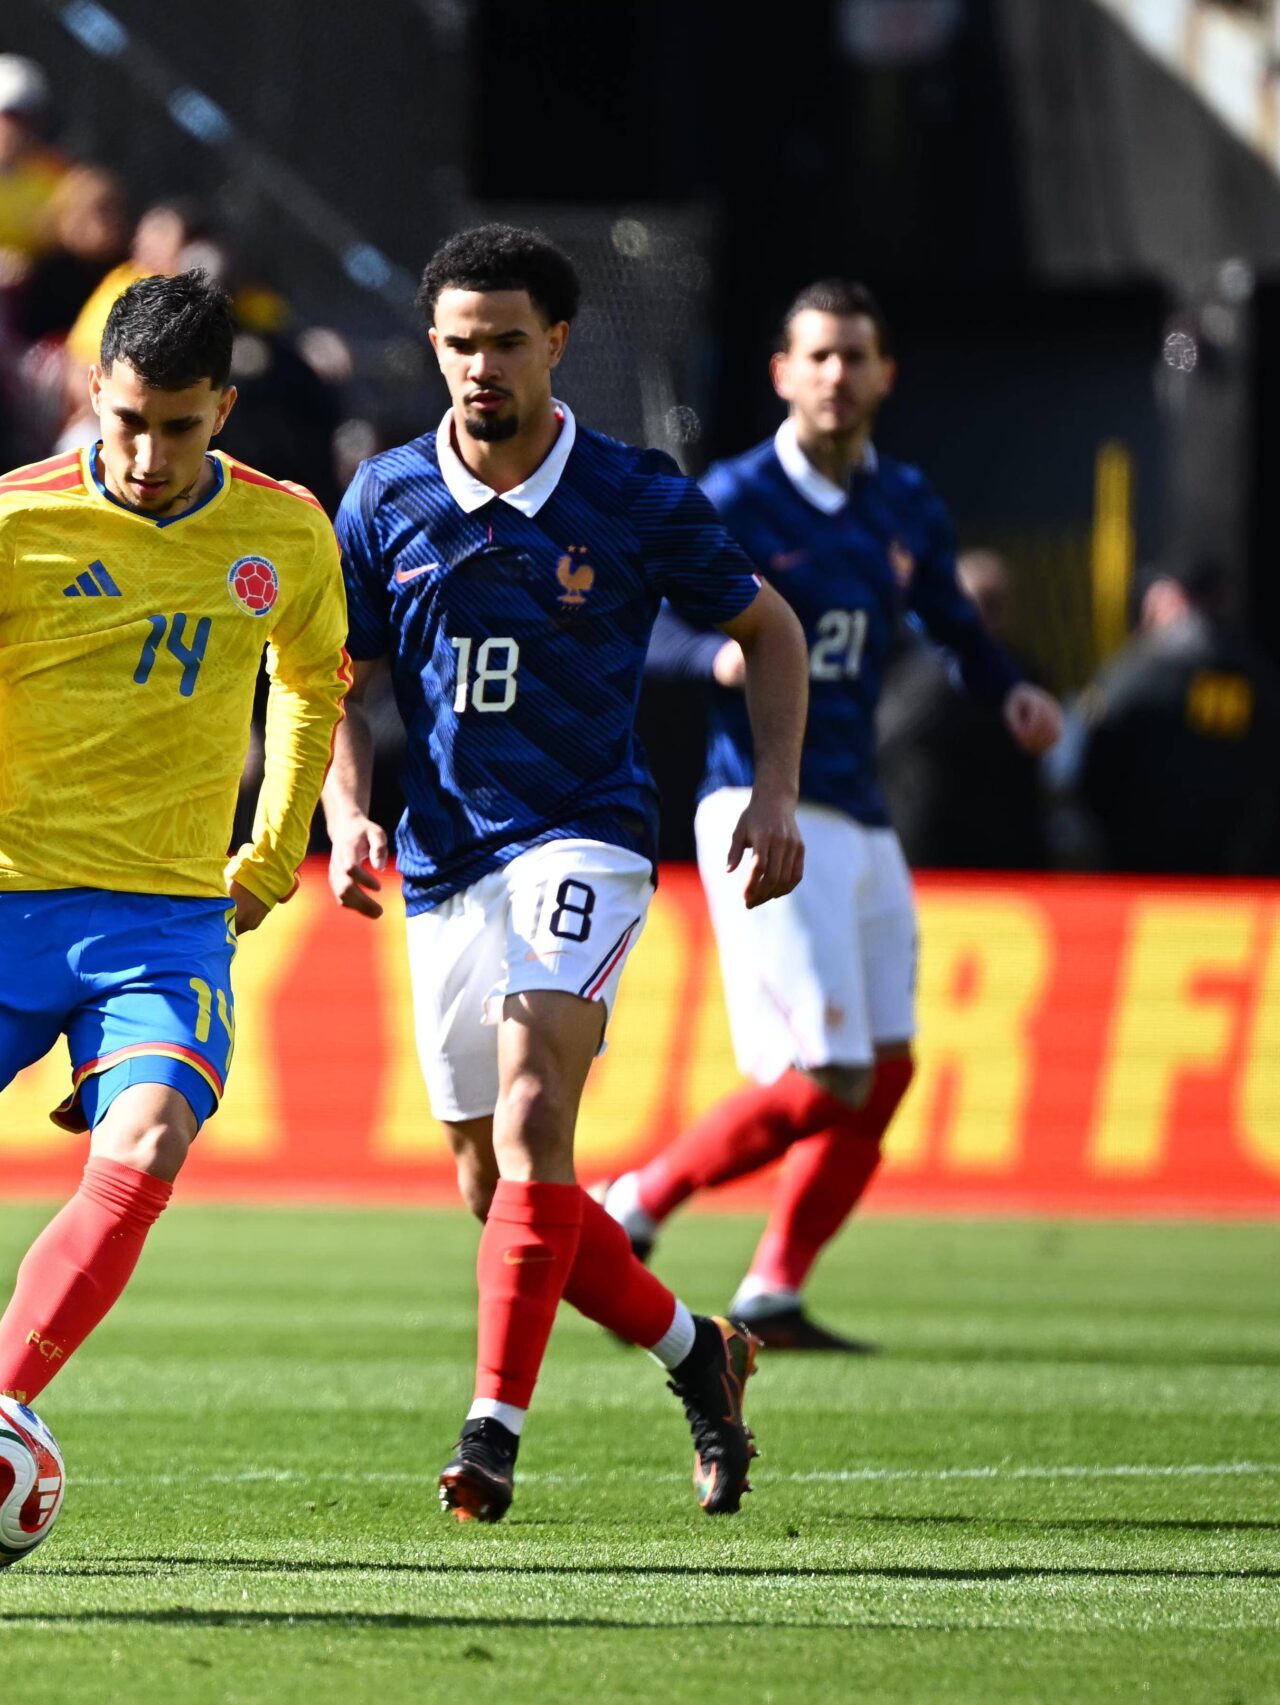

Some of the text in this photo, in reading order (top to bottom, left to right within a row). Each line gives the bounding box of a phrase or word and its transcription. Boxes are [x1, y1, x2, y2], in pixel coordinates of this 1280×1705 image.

[132, 612, 213, 697] 14
[451, 636, 520, 713] 18
[810, 609, 868, 679] 21
[529, 878, 596, 944] 18
[1088, 893, 1280, 1172] F
[25, 1329, 63, 1361] FCF
